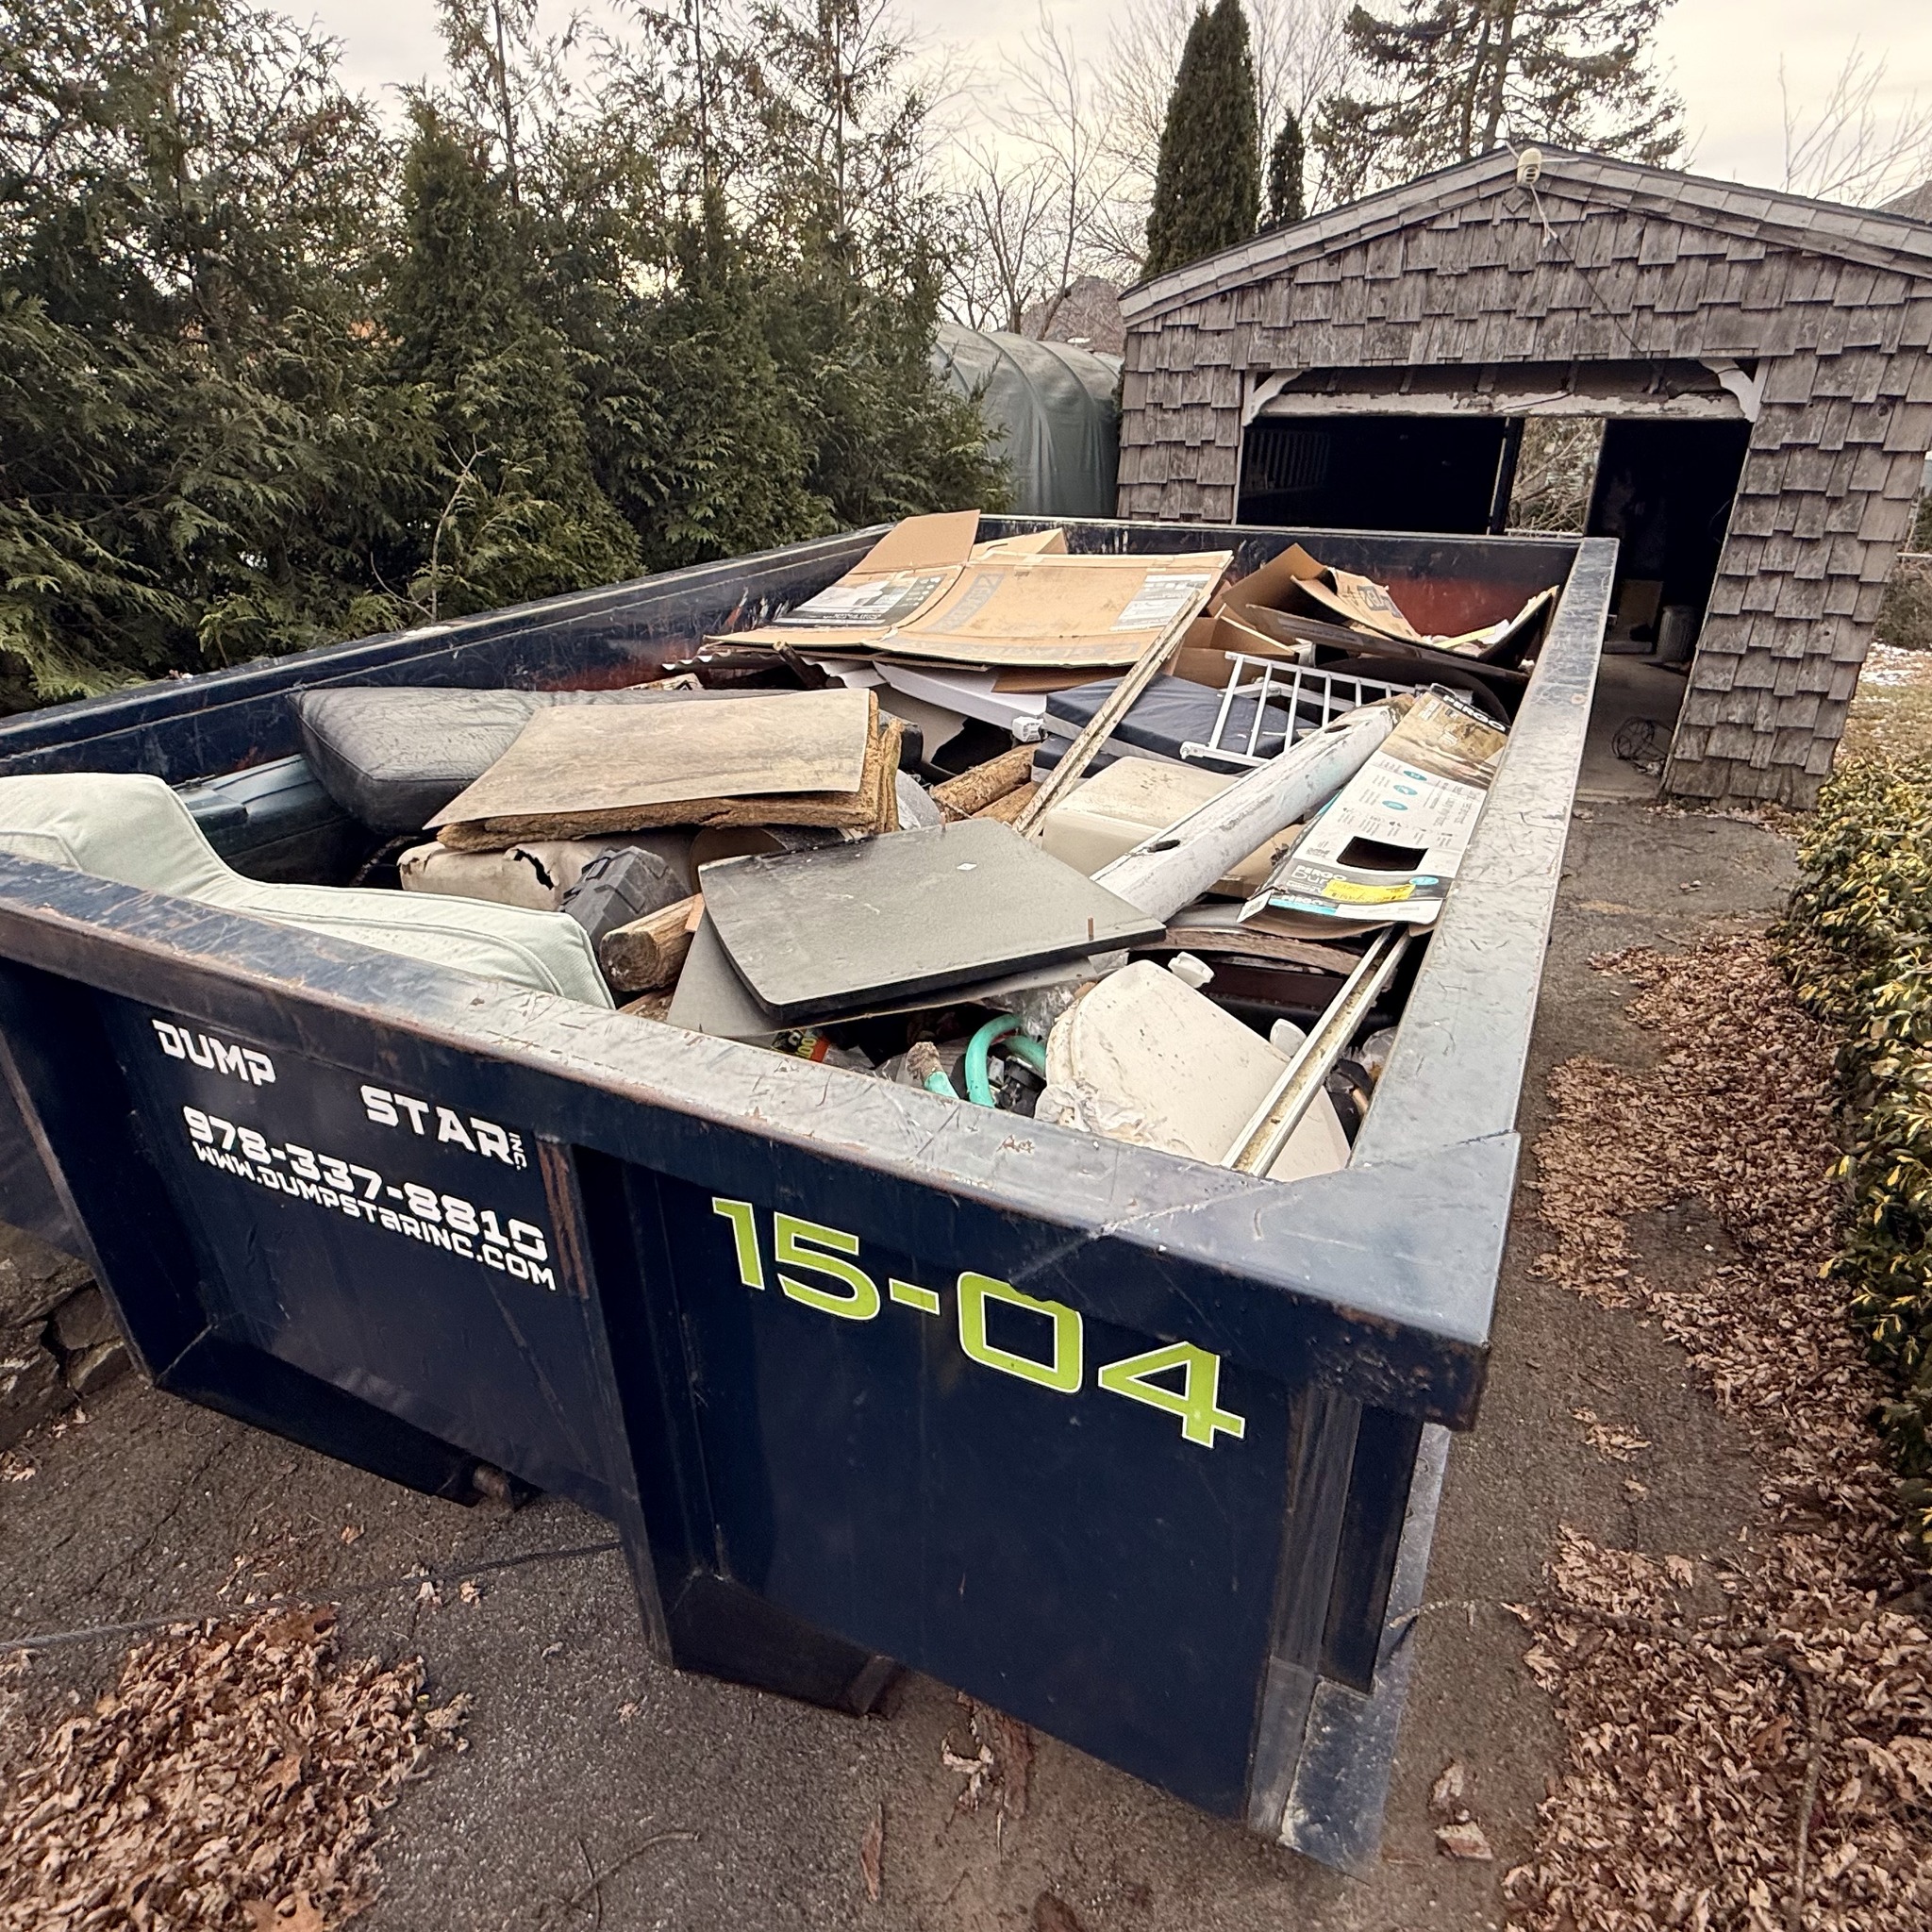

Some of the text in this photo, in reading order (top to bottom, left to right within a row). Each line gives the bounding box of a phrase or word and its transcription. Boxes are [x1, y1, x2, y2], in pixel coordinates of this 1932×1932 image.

[1442, 695, 1507, 732] PERGO
[152, 1019, 276, 1086] DUMP
[359, 1085, 515, 1167] STAR
[183, 1106, 548, 1262] 978-337-8810
[711, 1196, 1245, 1449] 15-04
